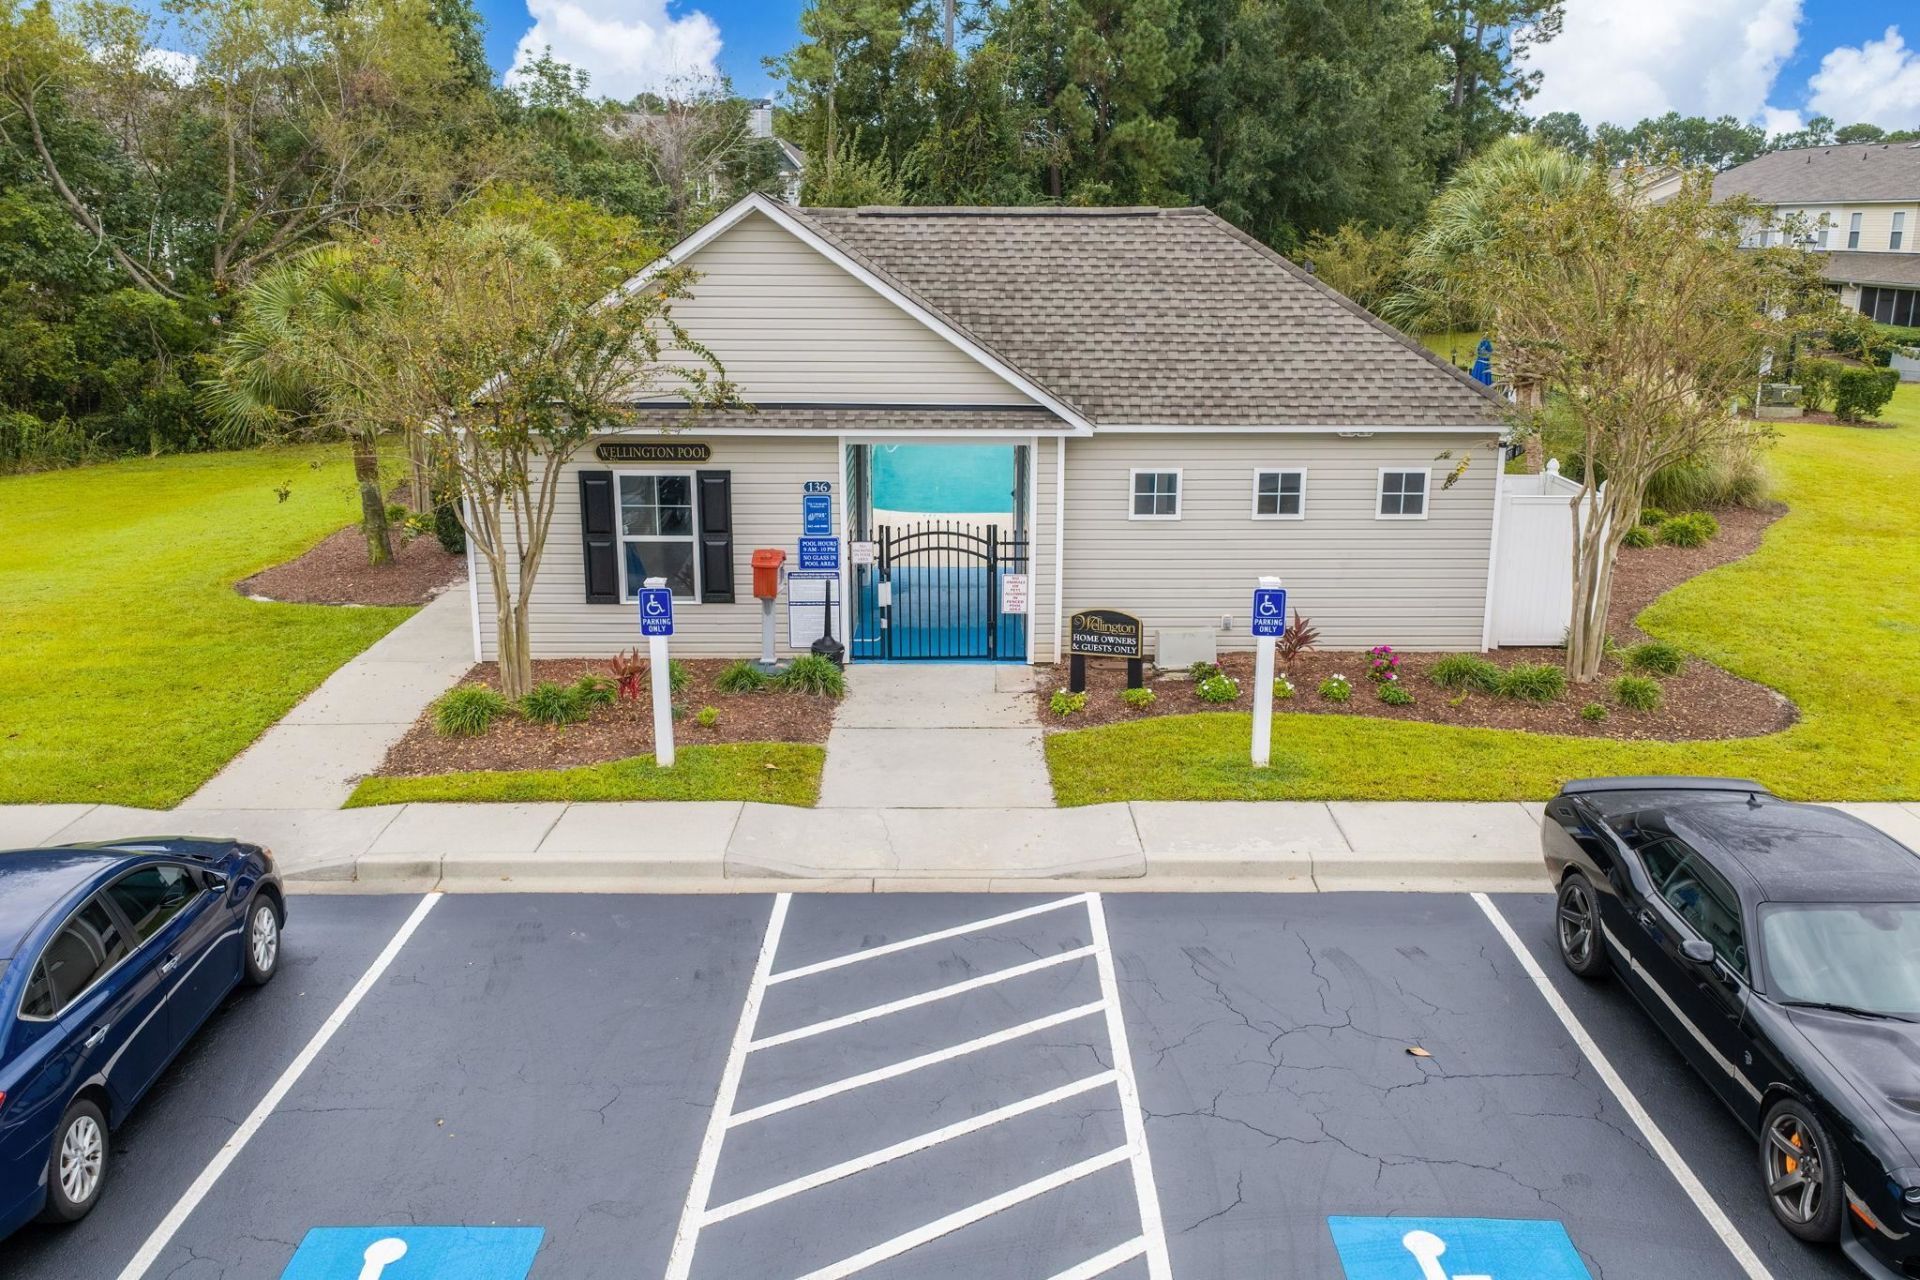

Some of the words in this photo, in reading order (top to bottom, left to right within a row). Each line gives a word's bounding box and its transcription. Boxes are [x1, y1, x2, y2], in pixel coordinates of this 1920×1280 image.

[599, 446, 674, 458] WELLINGTON
[678, 446, 709, 458] POOL
[808, 482, 828, 492] 136
[1073, 614, 1136, 634] Wellington
[1254, 618, 1283, 626] PARKING
[1073, 633, 1099, 643] HOME
[1100, 635, 1137, 645] OWNERS
[1072, 642, 1079, 650] &
[1081, 643, 1112, 652] GUESTS
[1113, 645, 1137, 654] ONLY
